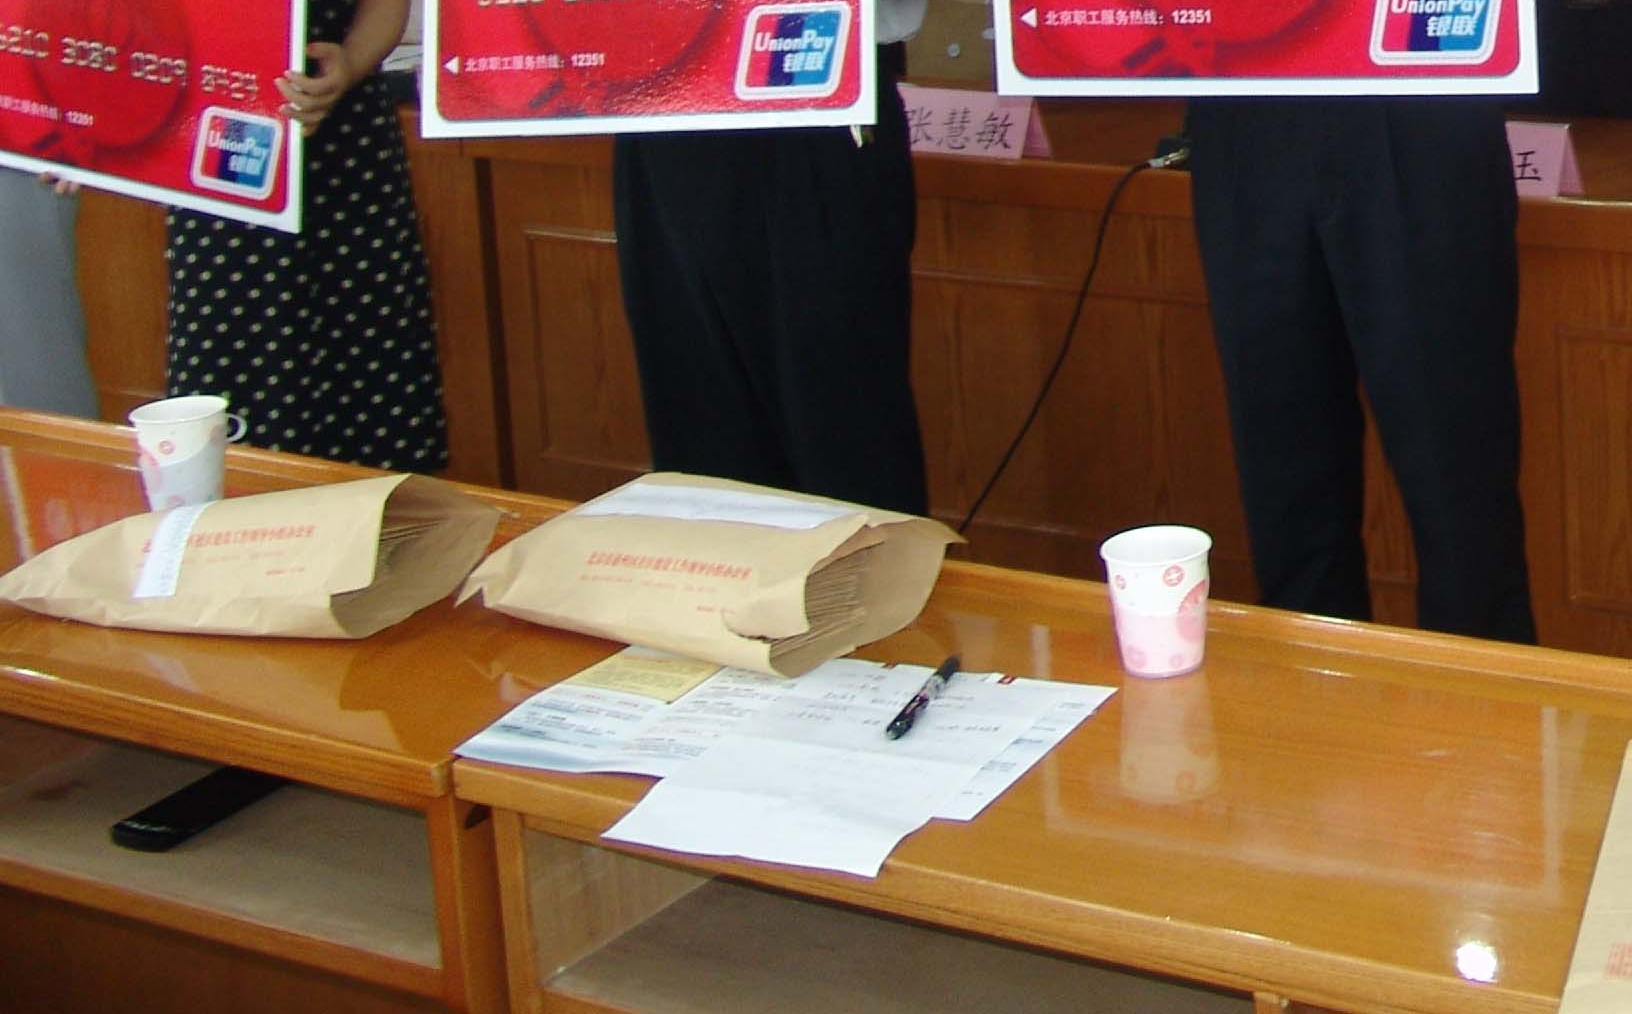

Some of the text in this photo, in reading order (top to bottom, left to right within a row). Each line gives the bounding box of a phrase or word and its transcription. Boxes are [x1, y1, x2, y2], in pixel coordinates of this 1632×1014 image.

[1171, 8, 1212, 25] 12351
[1426, 14, 1478, 37] 银联
[755, 29, 835, 53] UnionPay
[571, 52, 605, 69] 12351
